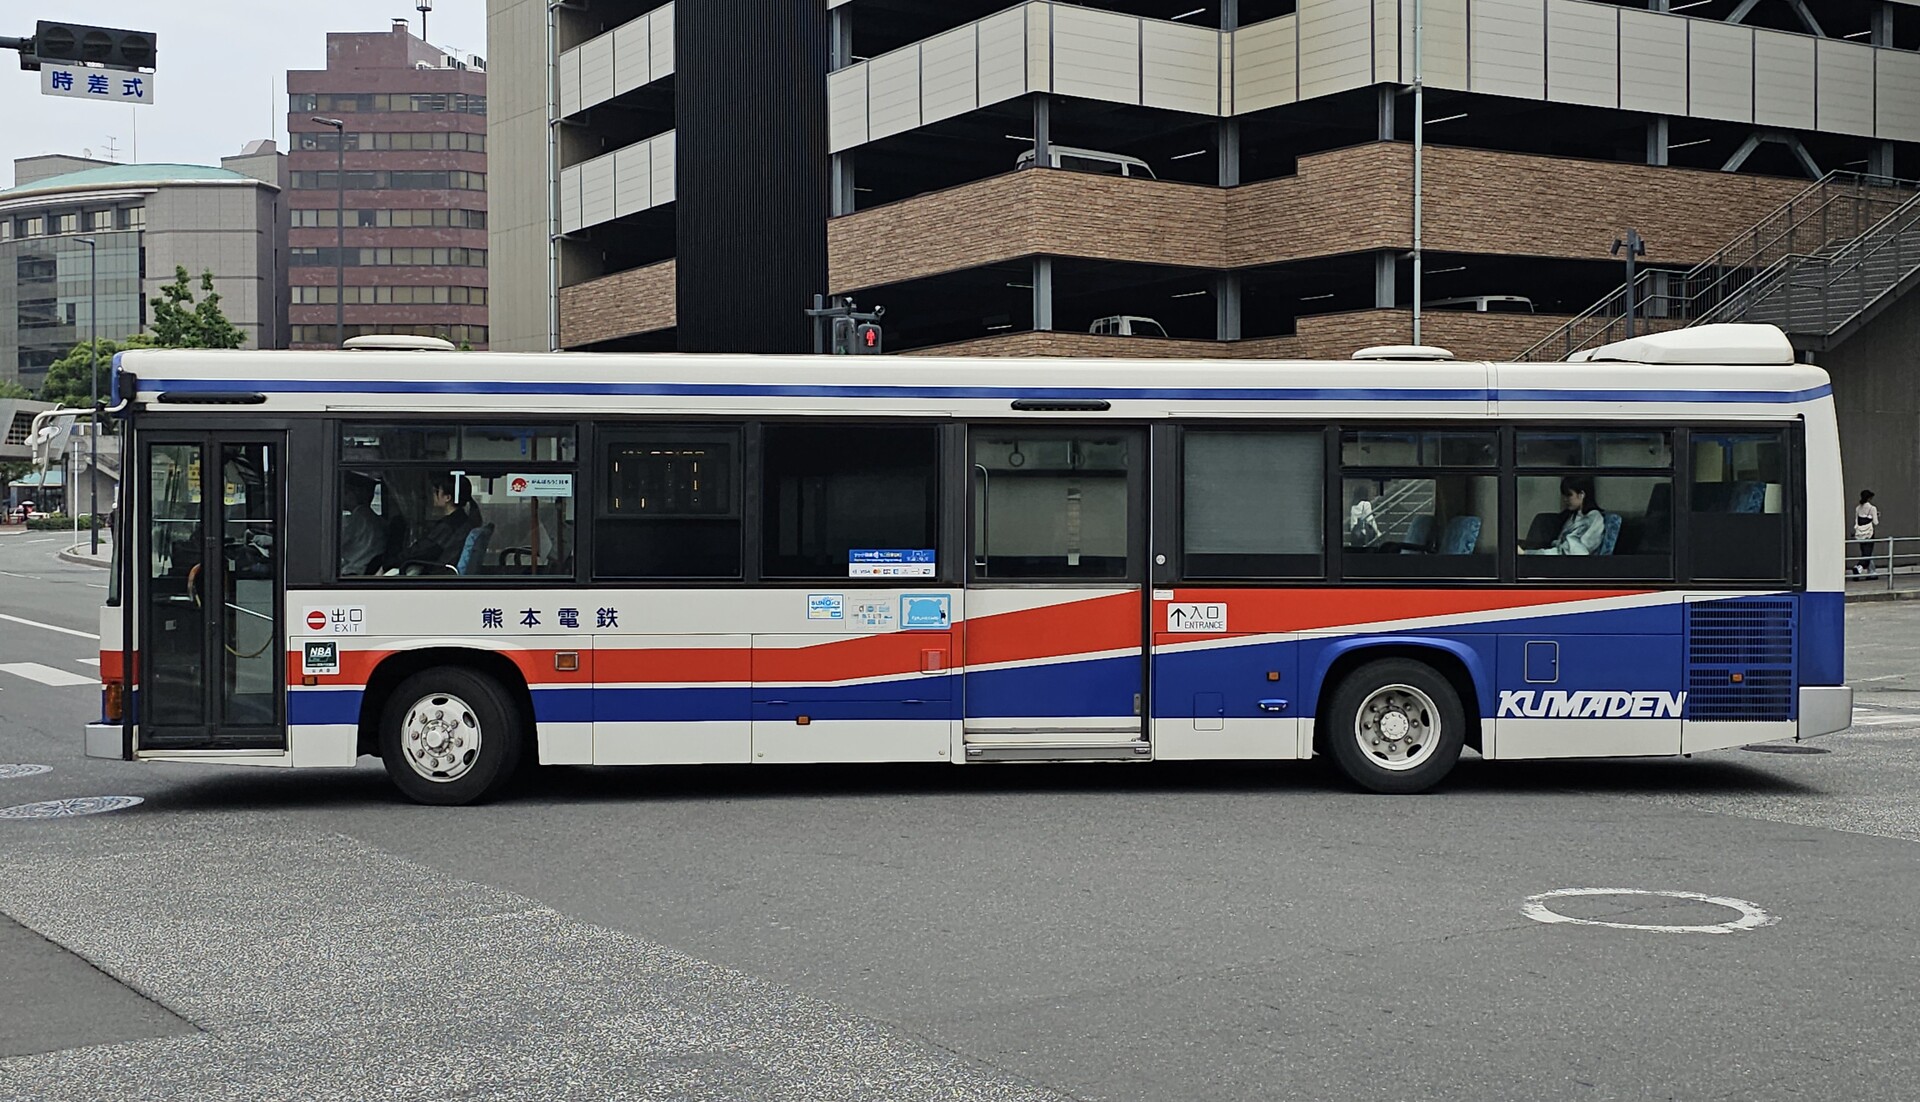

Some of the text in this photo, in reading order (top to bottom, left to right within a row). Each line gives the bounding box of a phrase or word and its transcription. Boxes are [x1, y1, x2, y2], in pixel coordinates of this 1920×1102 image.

[52, 71, 143, 97] 時差式
[331, 608, 362, 622] 出口
[481, 607, 618, 629] 熊本電鉄
[1190, 606, 1218, 619] 入口
[335, 624, 358, 632] EXIT
[1184, 621, 1223, 629] ENTRANCE
[310, 647, 331, 657] NBA
[1497, 691, 1687, 717] KUMADEN
